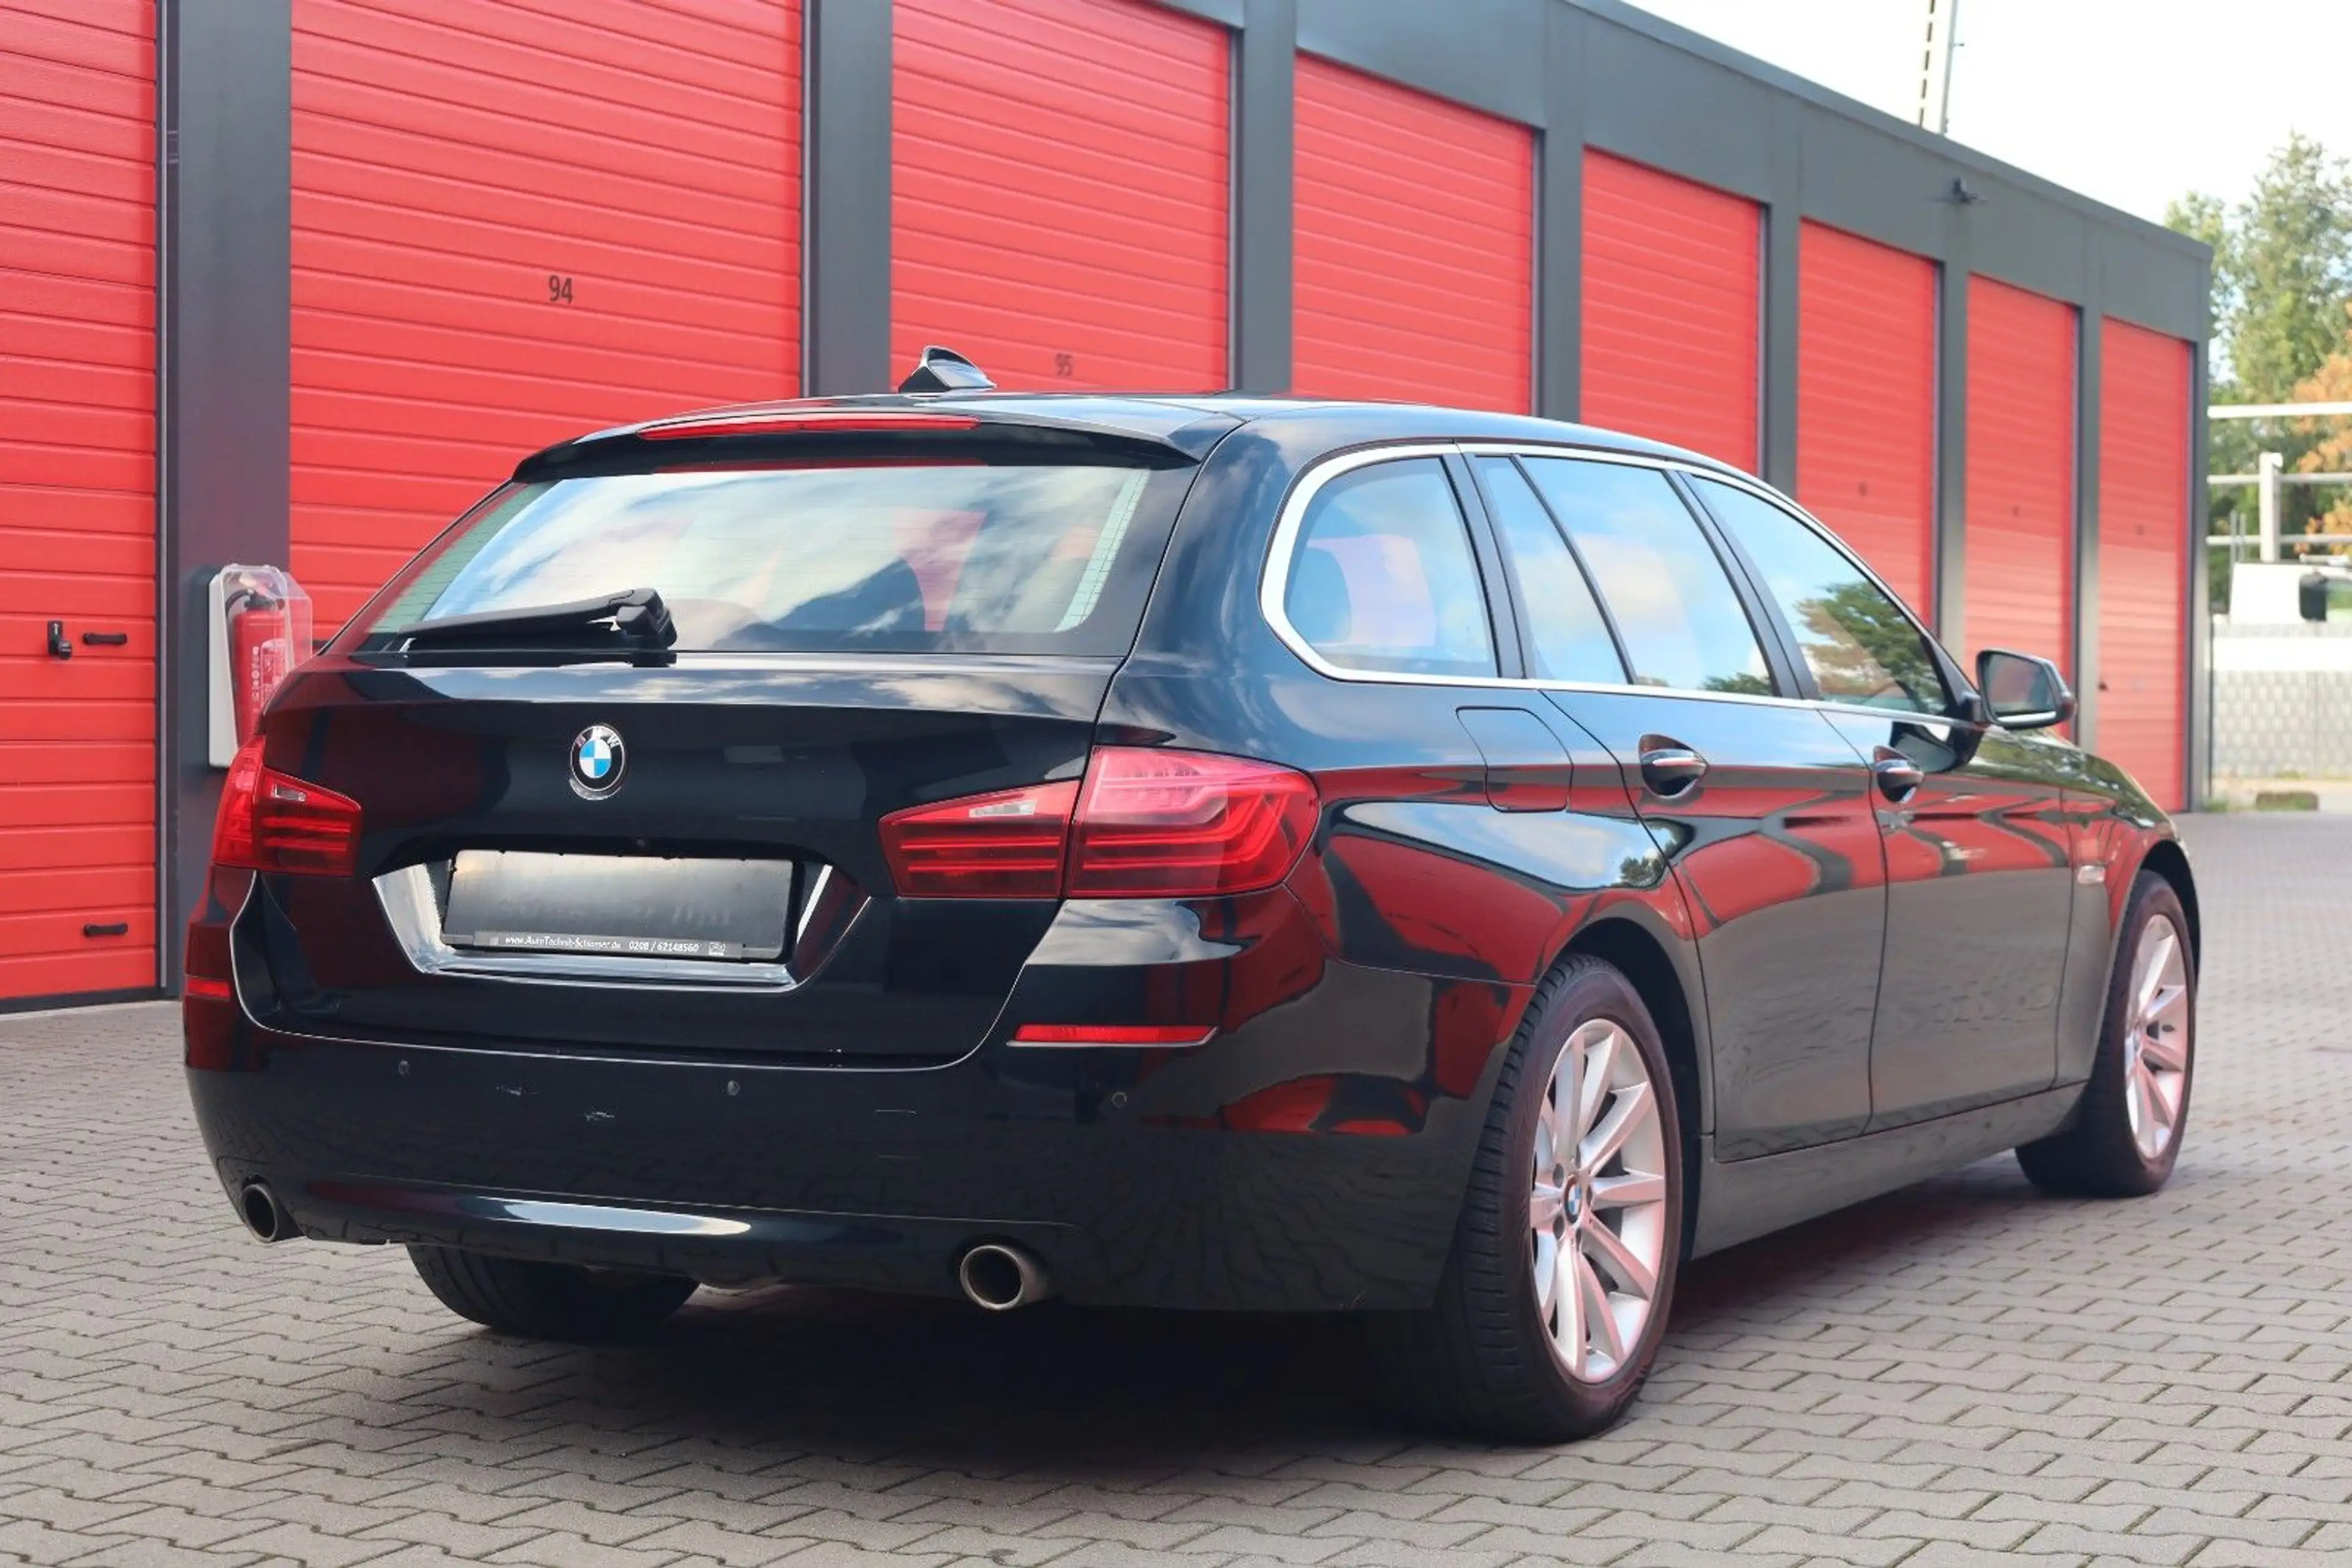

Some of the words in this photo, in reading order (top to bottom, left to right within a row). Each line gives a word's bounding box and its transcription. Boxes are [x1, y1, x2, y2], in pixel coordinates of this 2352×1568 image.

[548, 274, 573, 304] 94
[575, 726, 621, 748] BMW
[628, 940, 649, 951] 0208
